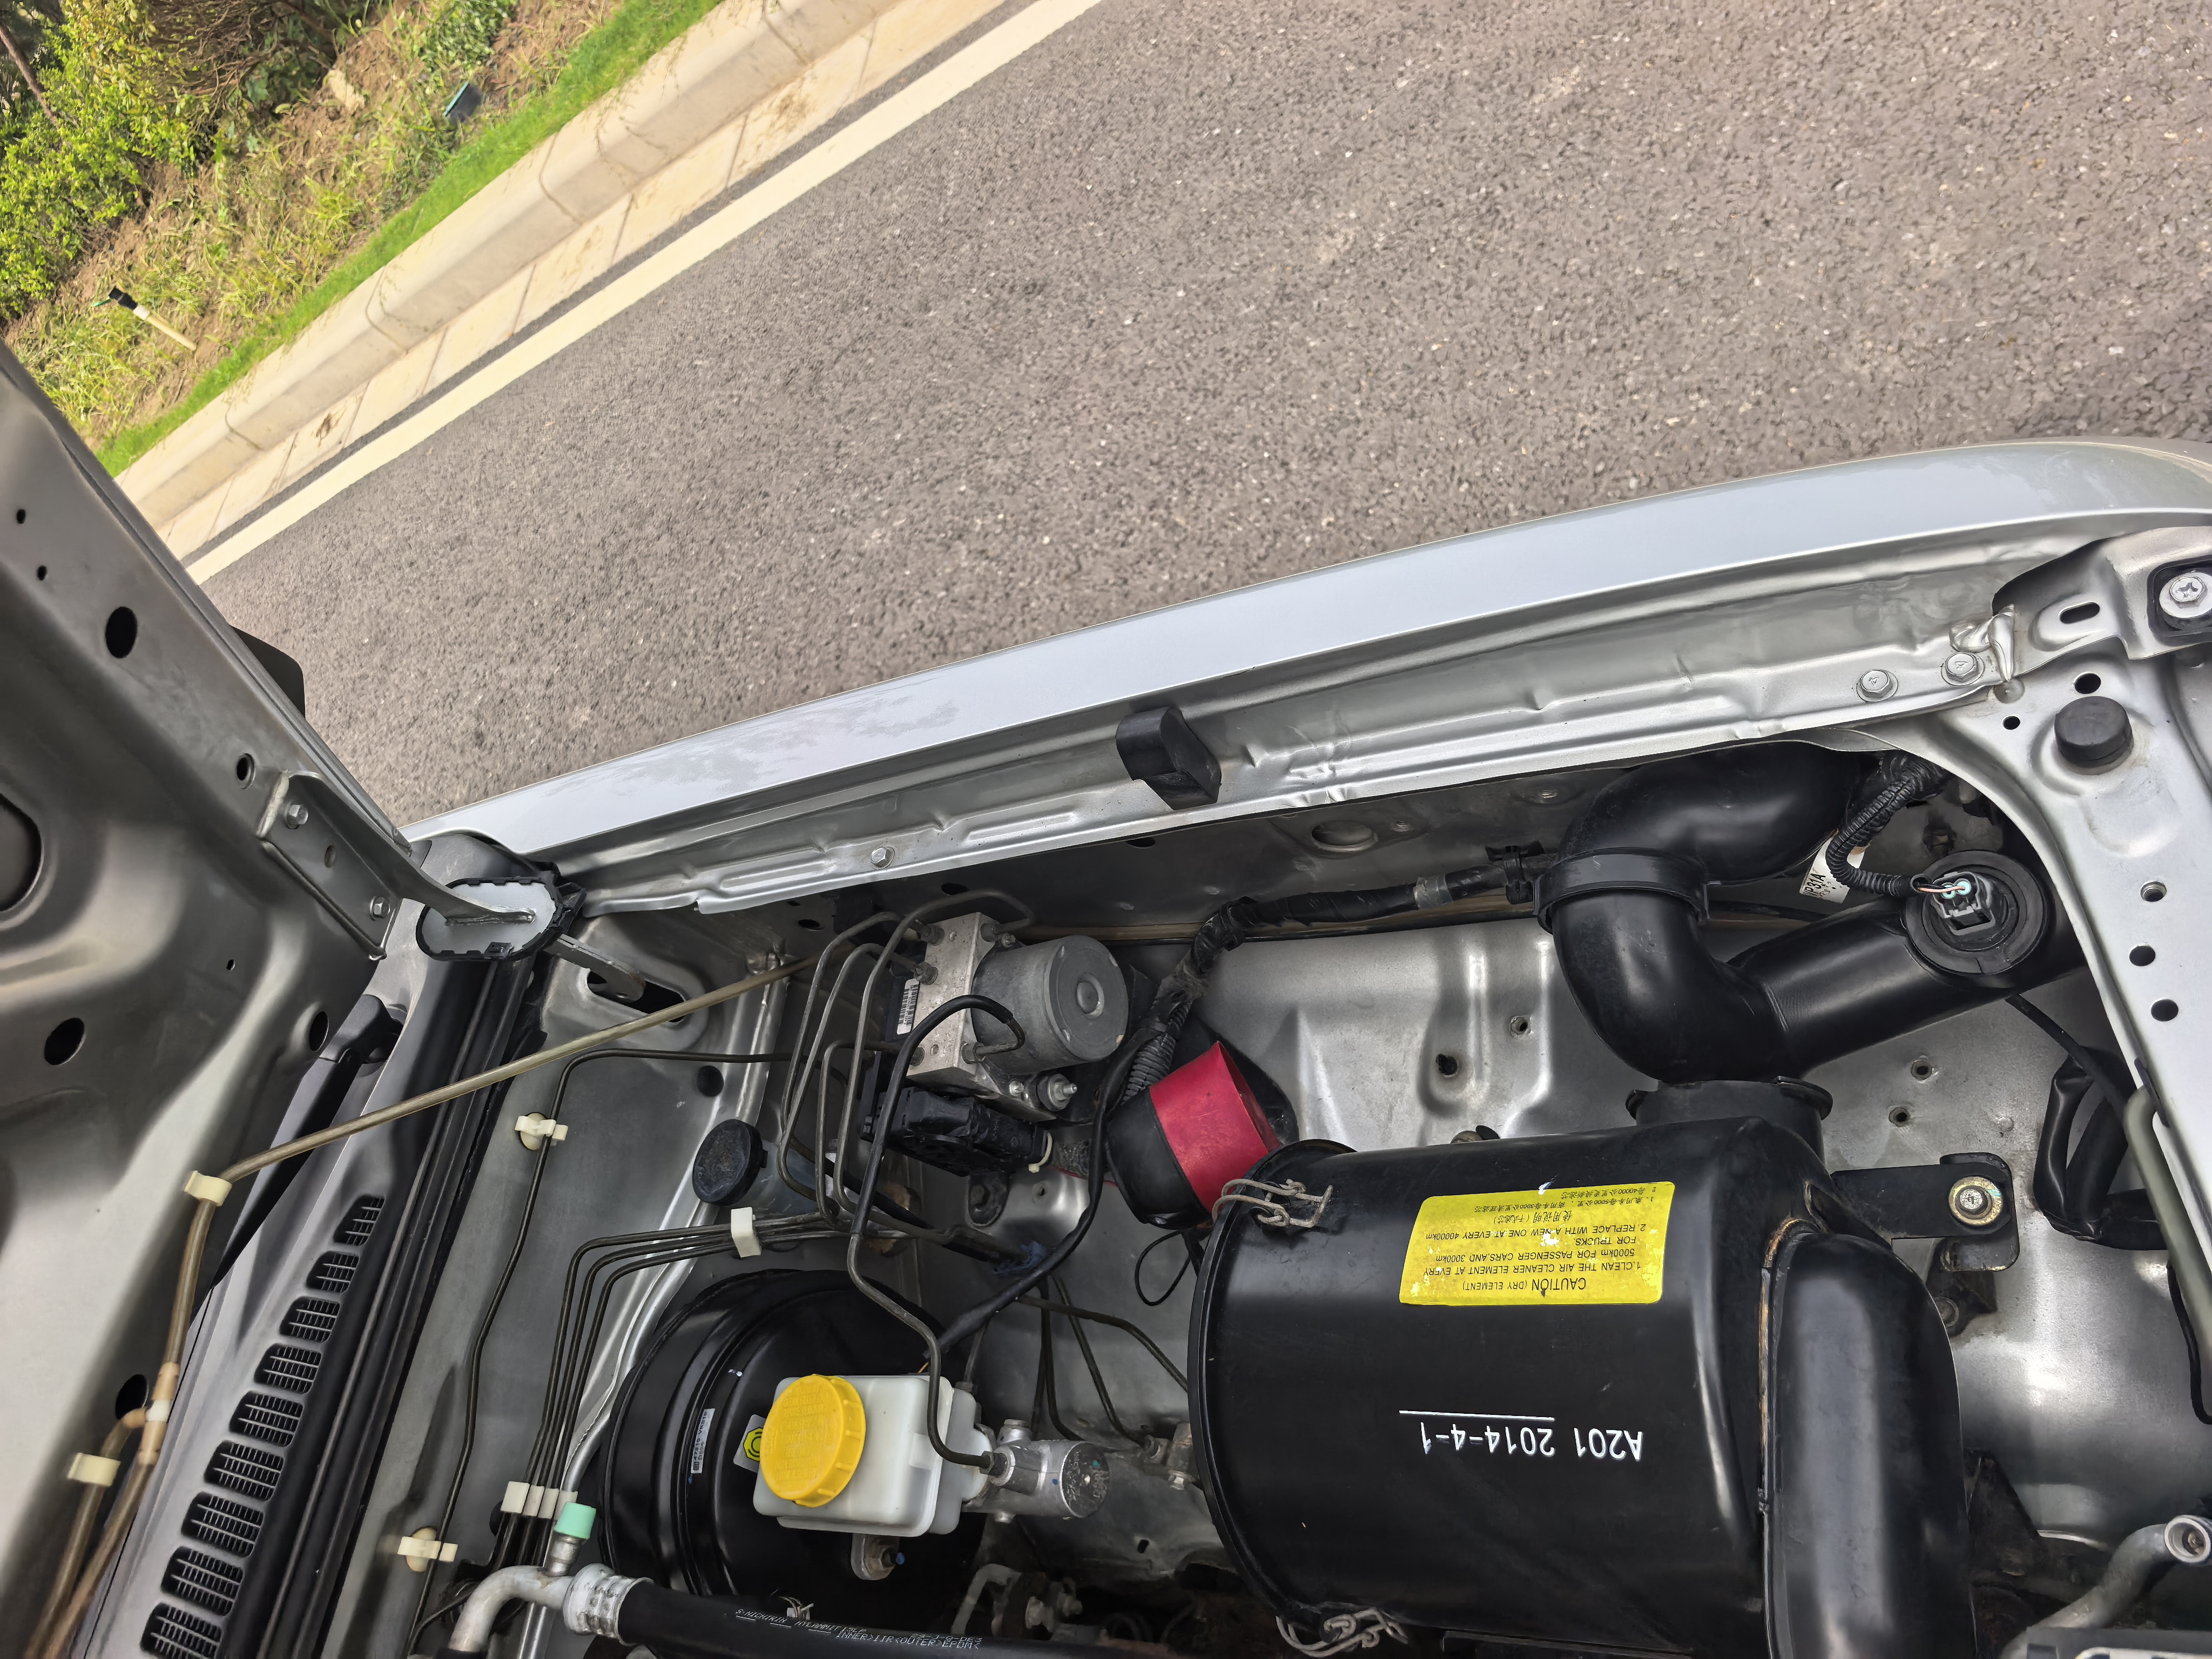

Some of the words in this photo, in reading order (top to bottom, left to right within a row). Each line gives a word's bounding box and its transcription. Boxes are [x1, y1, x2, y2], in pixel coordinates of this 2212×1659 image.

[1508, 1229, 1527, 1237] ONE
[1592, 1224, 1635, 1233] REPLACE
[1518, 1251, 1572, 1260] PASSENGER
[1601, 1249, 1635, 1257] 5000km
[1435, 1255, 1465, 1263] 3000km
[1424, 1267, 1451, 1276] EVERY
[1455, 1267, 1465, 1275] AT
[1468, 1266, 1508, 1274] ELEMENT
[1513, 1264, 1555, 1273] CLEANER
[1559, 1264, 1574, 1272] AIR
[1579, 1263, 1596, 1271] THE
[1463, 1281, 1503, 1290] ELEMENT)
[1507, 1280, 1527, 1290] (DRY
[1532, 1278, 1586, 1291] CAUTION
[1419, 1422, 1555, 1457] 2014-4-1
[1573, 1427, 1643, 1461] A201
